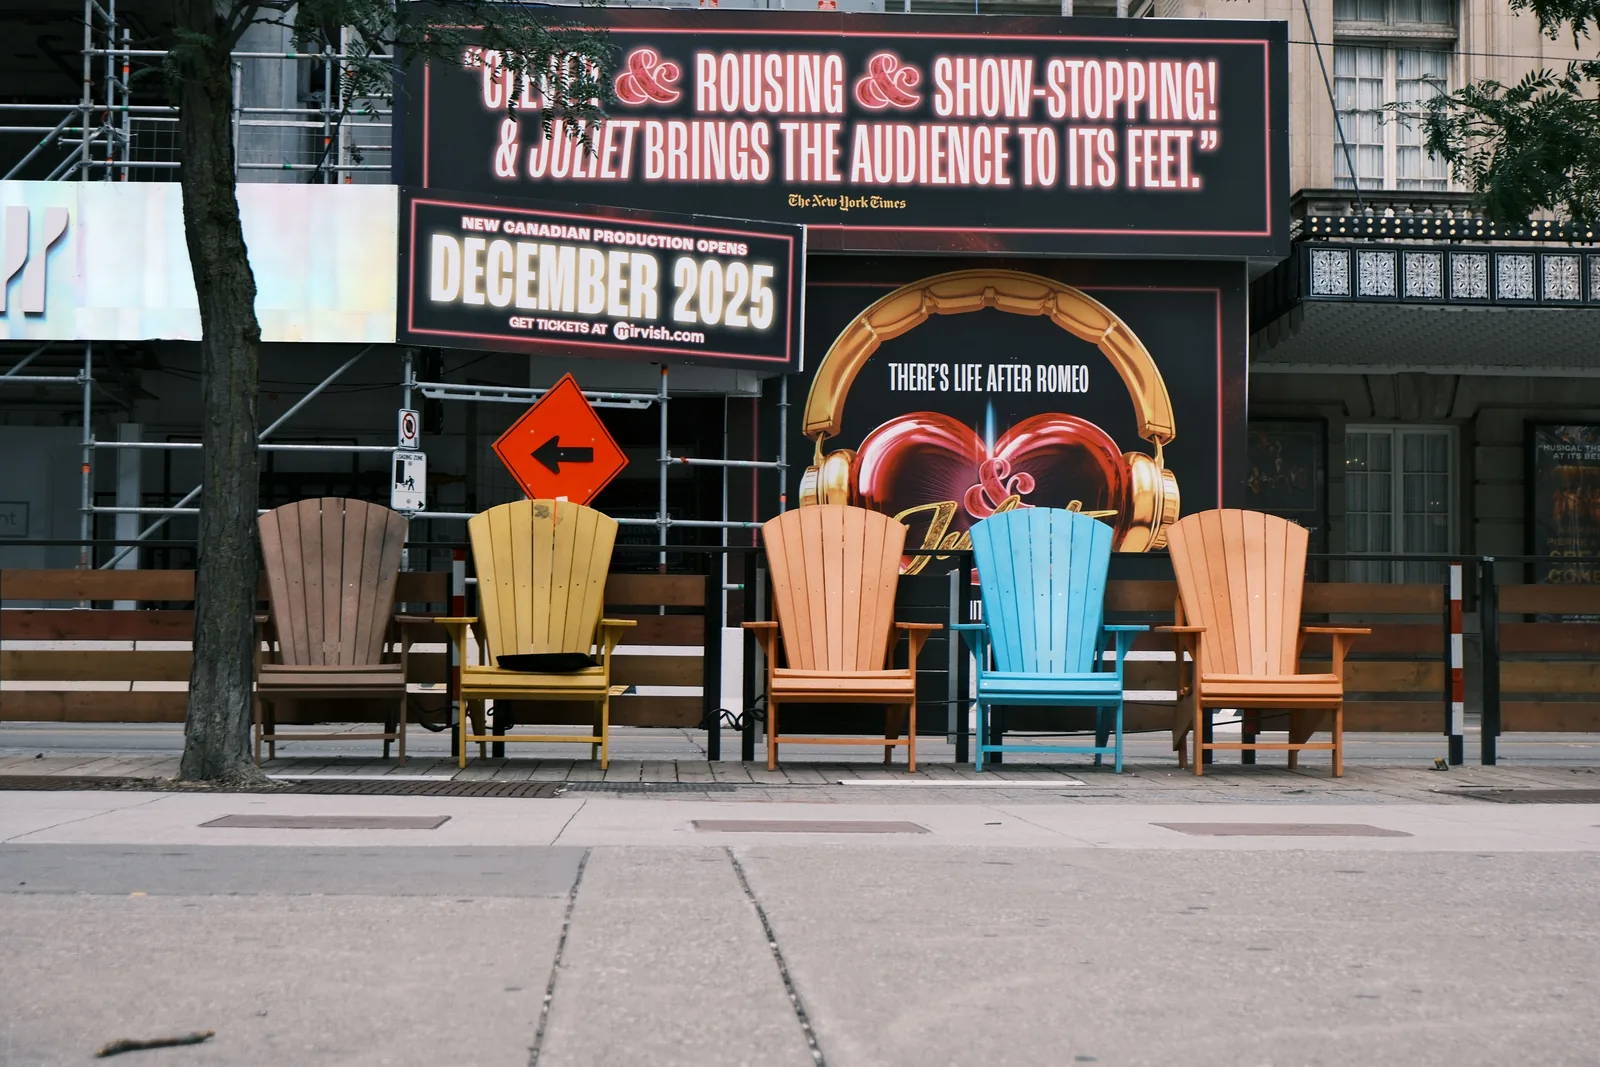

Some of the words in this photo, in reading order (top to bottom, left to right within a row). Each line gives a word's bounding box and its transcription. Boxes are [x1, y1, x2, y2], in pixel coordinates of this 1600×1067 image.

[616, 49, 680, 104] &
[697, 53, 843, 113] ROUSING
[855, 53, 920, 108] &
[934, 57, 1217, 120] SHOW-STOPPING!
[495, 118, 518, 177] &
[529, 119, 640, 178] JULIET
[645, 121, 770, 181] BRINGS
[780, 122, 842, 182] THE
[851, 124, 1010, 185] AUDIENCE
[1018, 127, 1056, 186] TO
[1069, 128, 1115, 187] ITS
[1127, 129, 1217, 188] FEET.”
[788, 193, 811, 208] The
[812, 194, 837, 208] New
[839, 195, 869, 212] York
[870, 195, 907, 209] Times
[462, 216, 500, 231] NEW
[503, 220, 591, 241] CANADIAN
[593, 229, 694, 251] PRODUCTION
[696, 240, 748, 256] OPENS
[430, 233, 660, 320] DECEMBER
[673, 256, 775, 330] 2025
[509, 316, 535, 329] GET
[536, 319, 589, 334] TICKETS
[591, 323, 608, 335] AT
[613, 321, 705, 343] mirvish.com
[888, 363, 949, 392] THERE’S
[954, 363, 983, 392] LIFE
[986, 364, 1032, 392] AFTER
[1036, 364, 1089, 393] ROMEO
